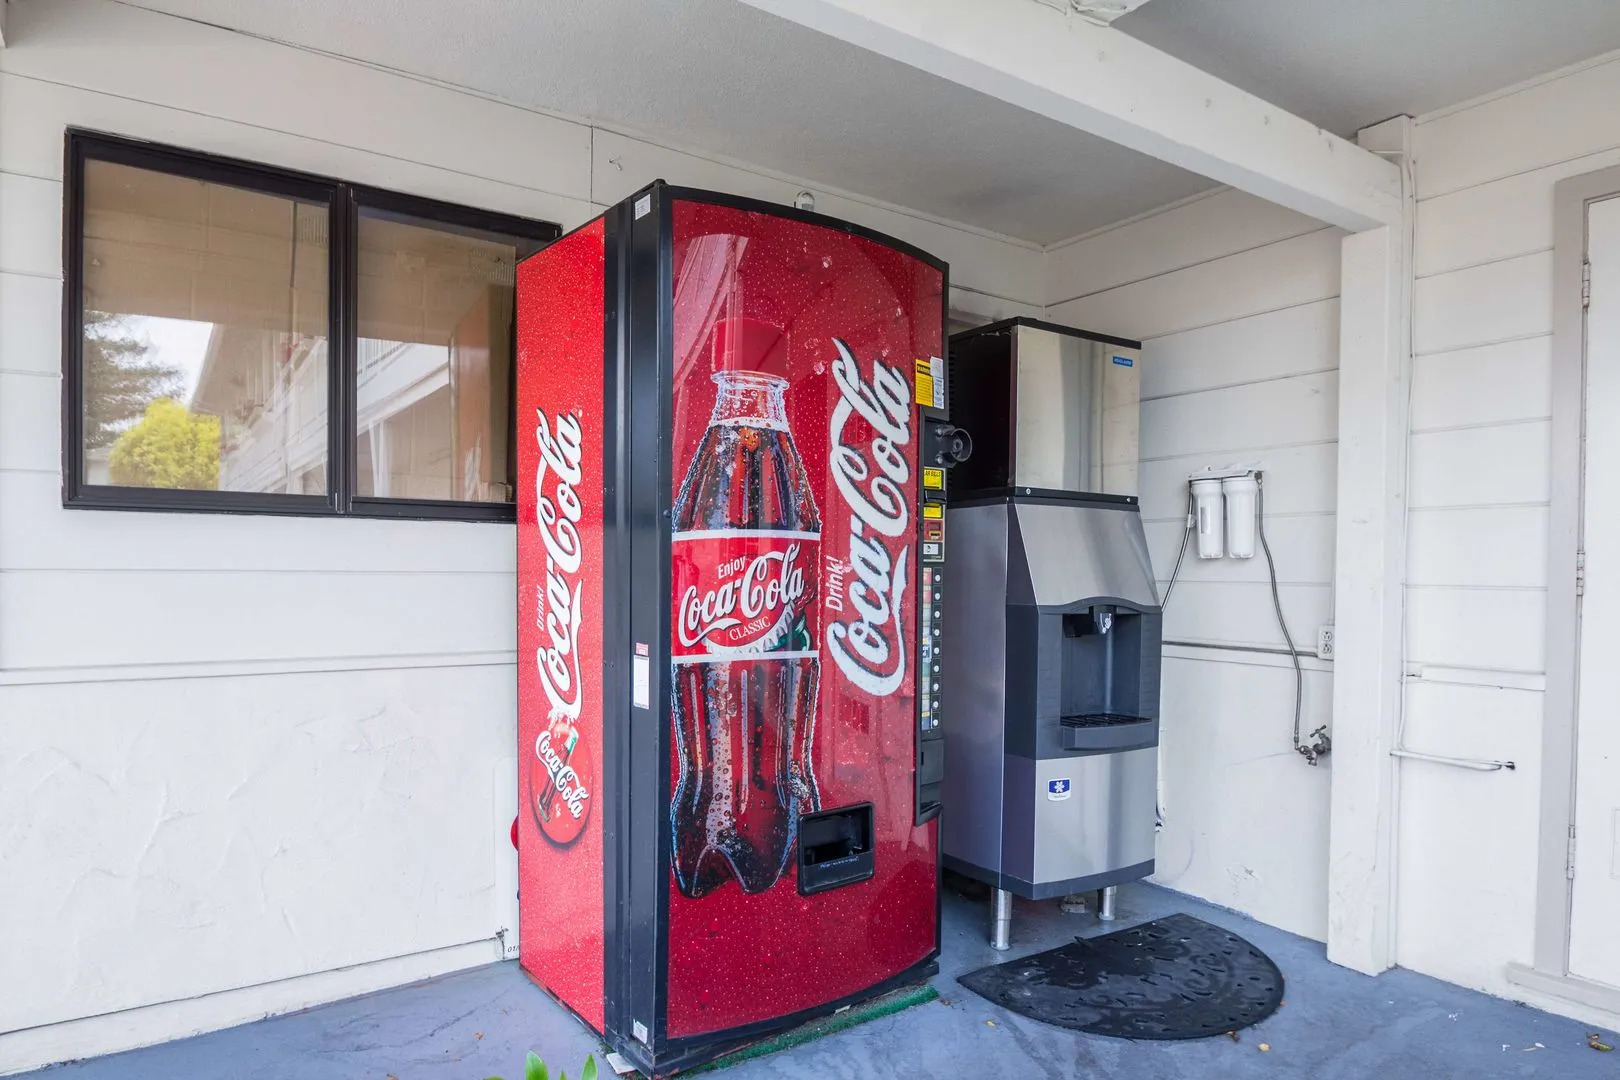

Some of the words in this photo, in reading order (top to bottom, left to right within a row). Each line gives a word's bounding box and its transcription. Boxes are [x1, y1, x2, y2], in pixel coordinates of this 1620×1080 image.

[827, 337, 911, 697] Coca-Cola
[536, 407, 583, 719] Coca-Cola
[678, 542, 805, 648] Coca-Cola
[717, 556, 746, 579] Enjoy
[826, 556, 844, 612] Drink!
[536, 584, 545, 632] Drink!
[729, 616, 771, 641] CLASSIC
[536, 731, 589, 819] Coca-Cola
